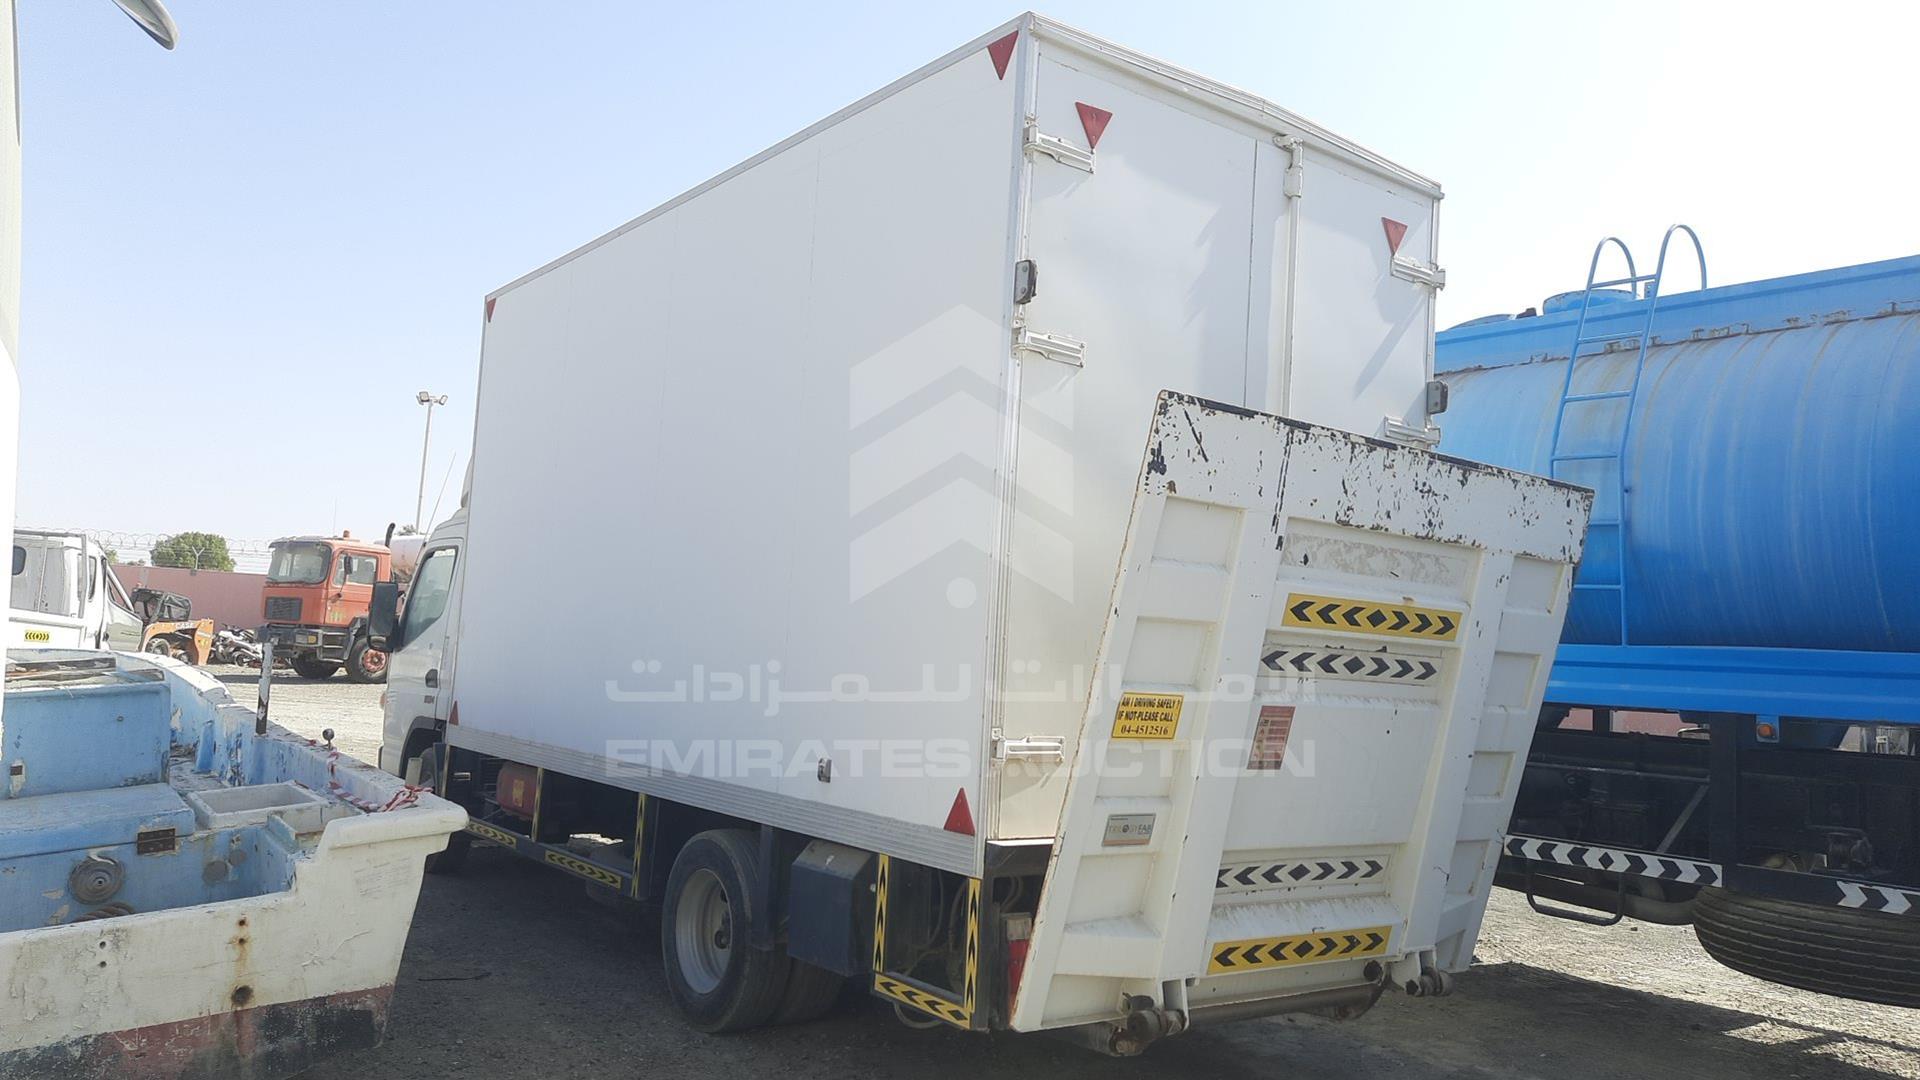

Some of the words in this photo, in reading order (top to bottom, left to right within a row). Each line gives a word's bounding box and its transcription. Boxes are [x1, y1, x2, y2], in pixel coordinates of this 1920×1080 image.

[1121, 697, 1131, 707] AM
[1134, 697, 1157, 708] DRIVING
[1157, 698, 1176, 709] SAFELY
[1117, 710, 1124, 720] IF
[1160, 711, 1174, 722] CALL
[1121, 725, 1168, 735] 04-4512516
